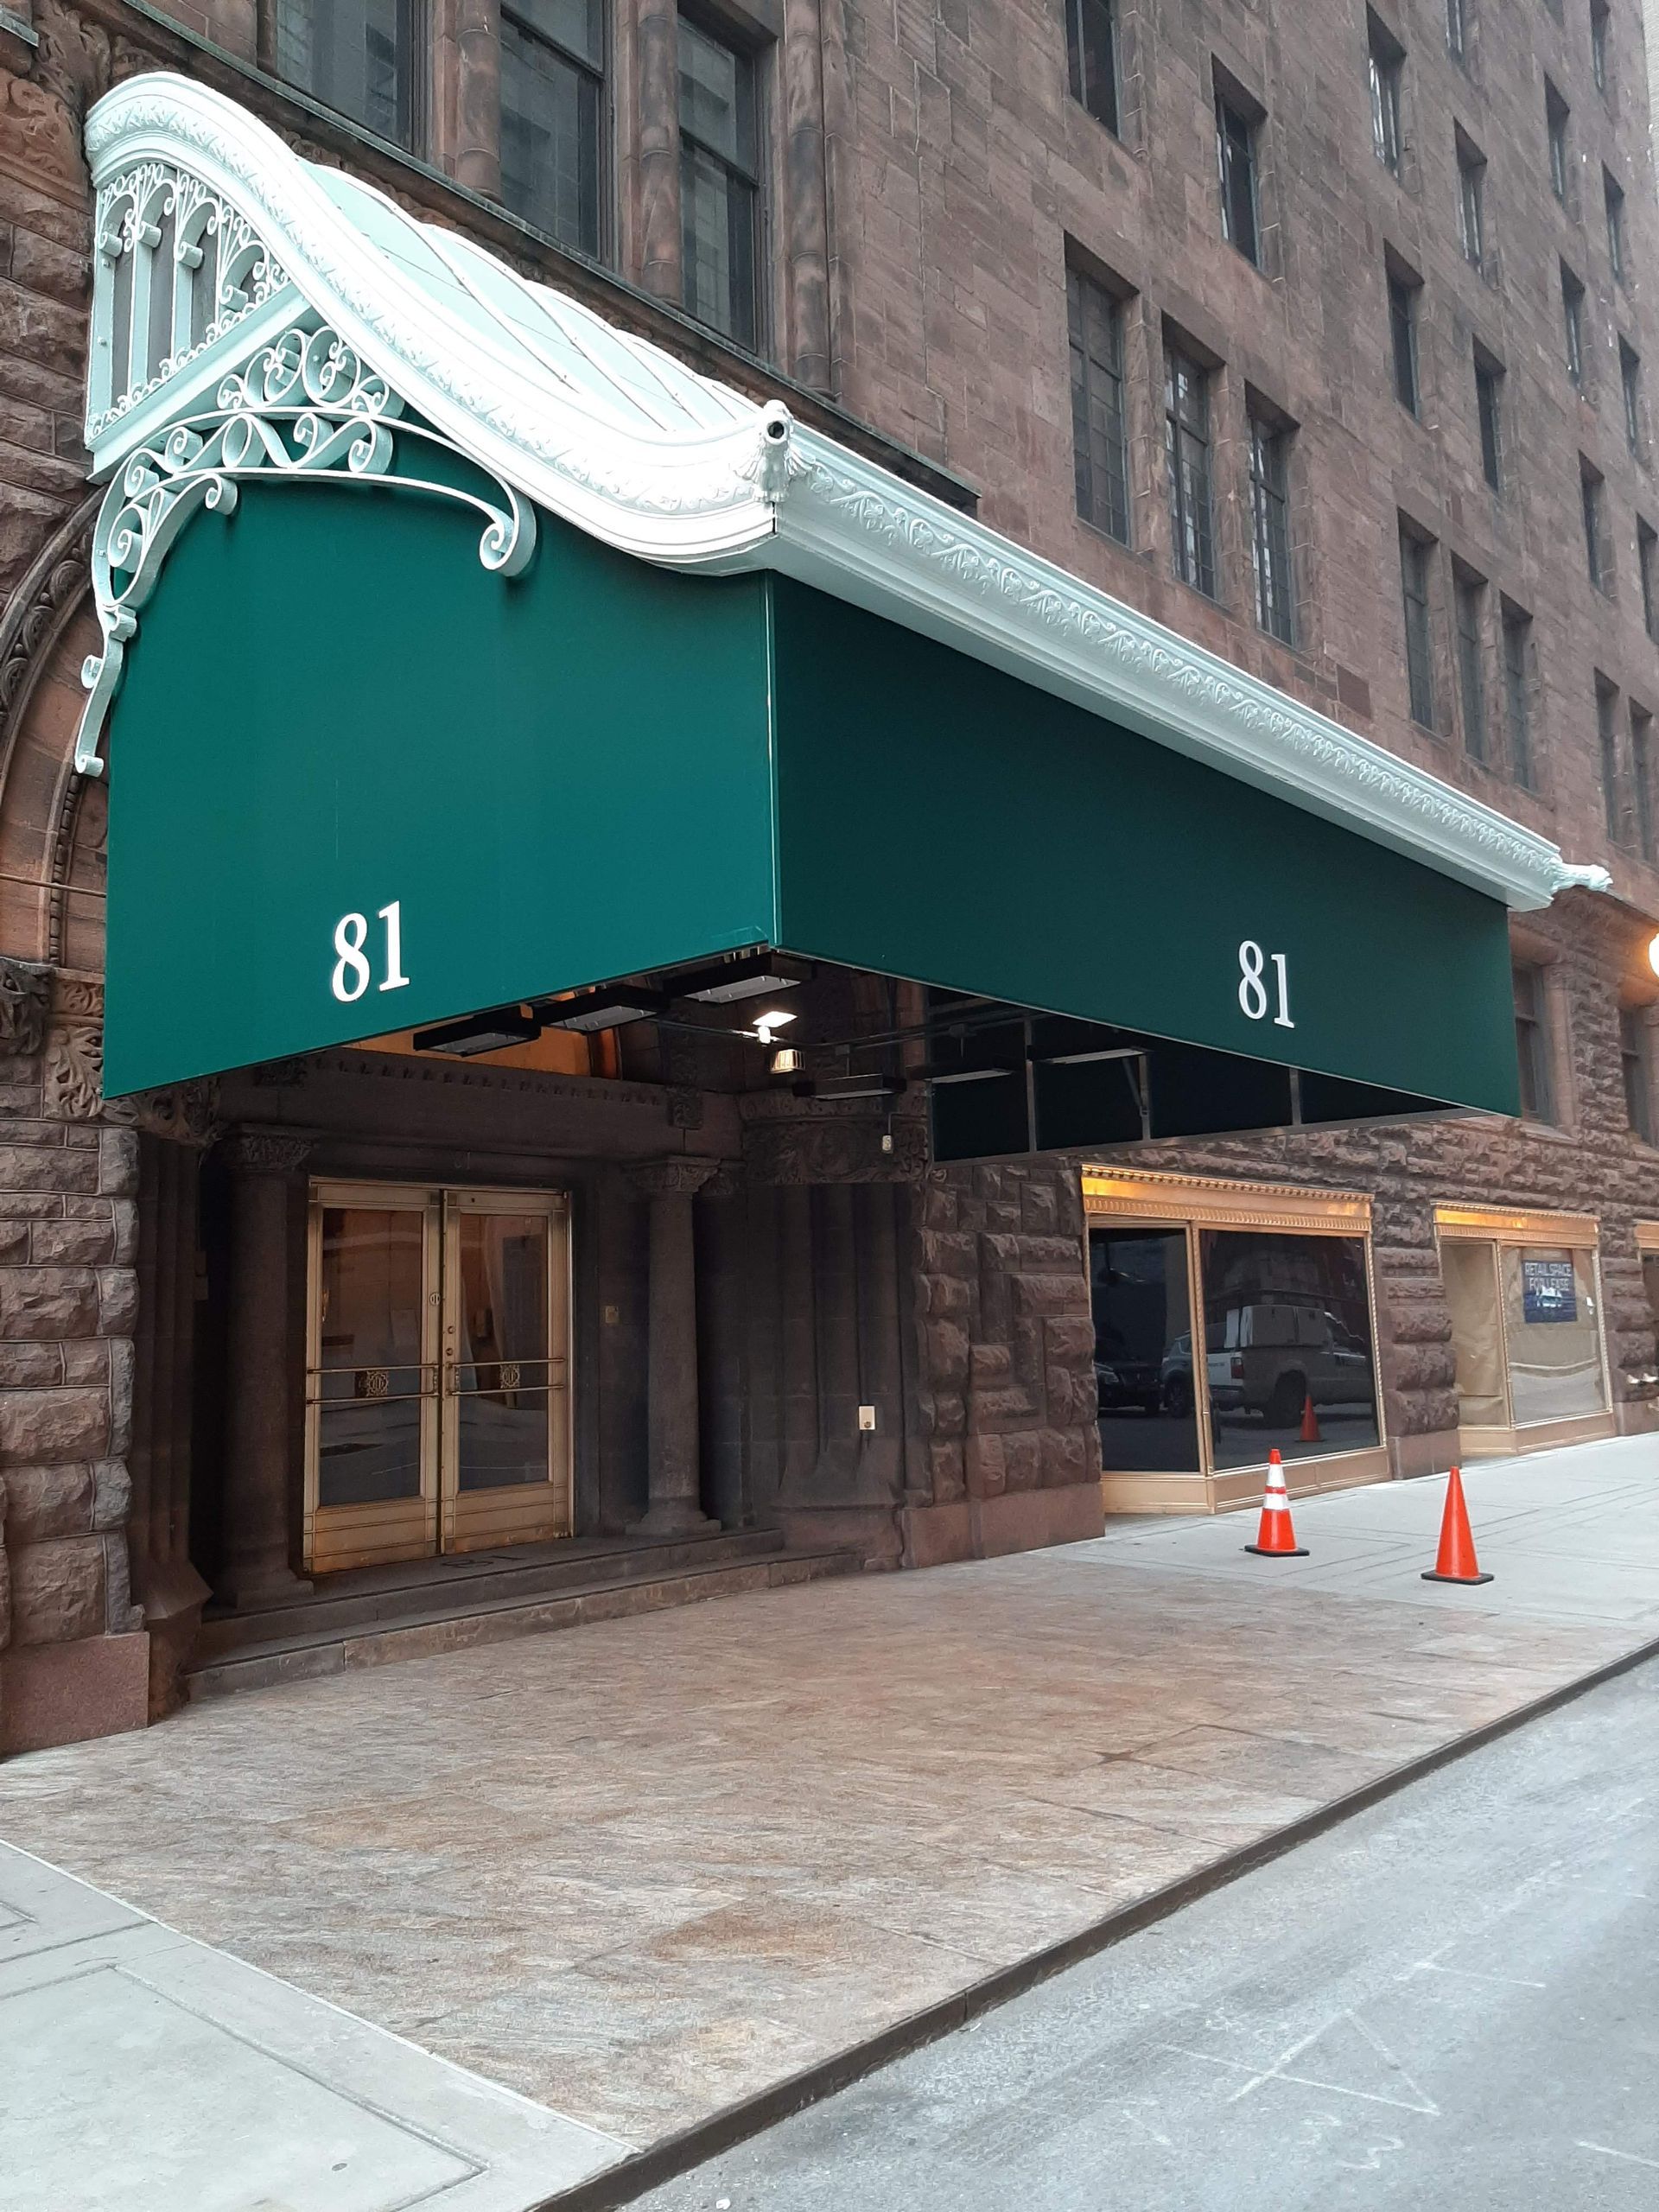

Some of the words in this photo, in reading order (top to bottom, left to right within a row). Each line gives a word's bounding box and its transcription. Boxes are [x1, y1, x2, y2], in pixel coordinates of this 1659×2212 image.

[332, 900, 410, 1002] 81
[1238, 940, 1294, 1028] 81
[1525, 1262, 1548, 1276] RETAIL
[1549, 1263, 1572, 1277] SPACE
